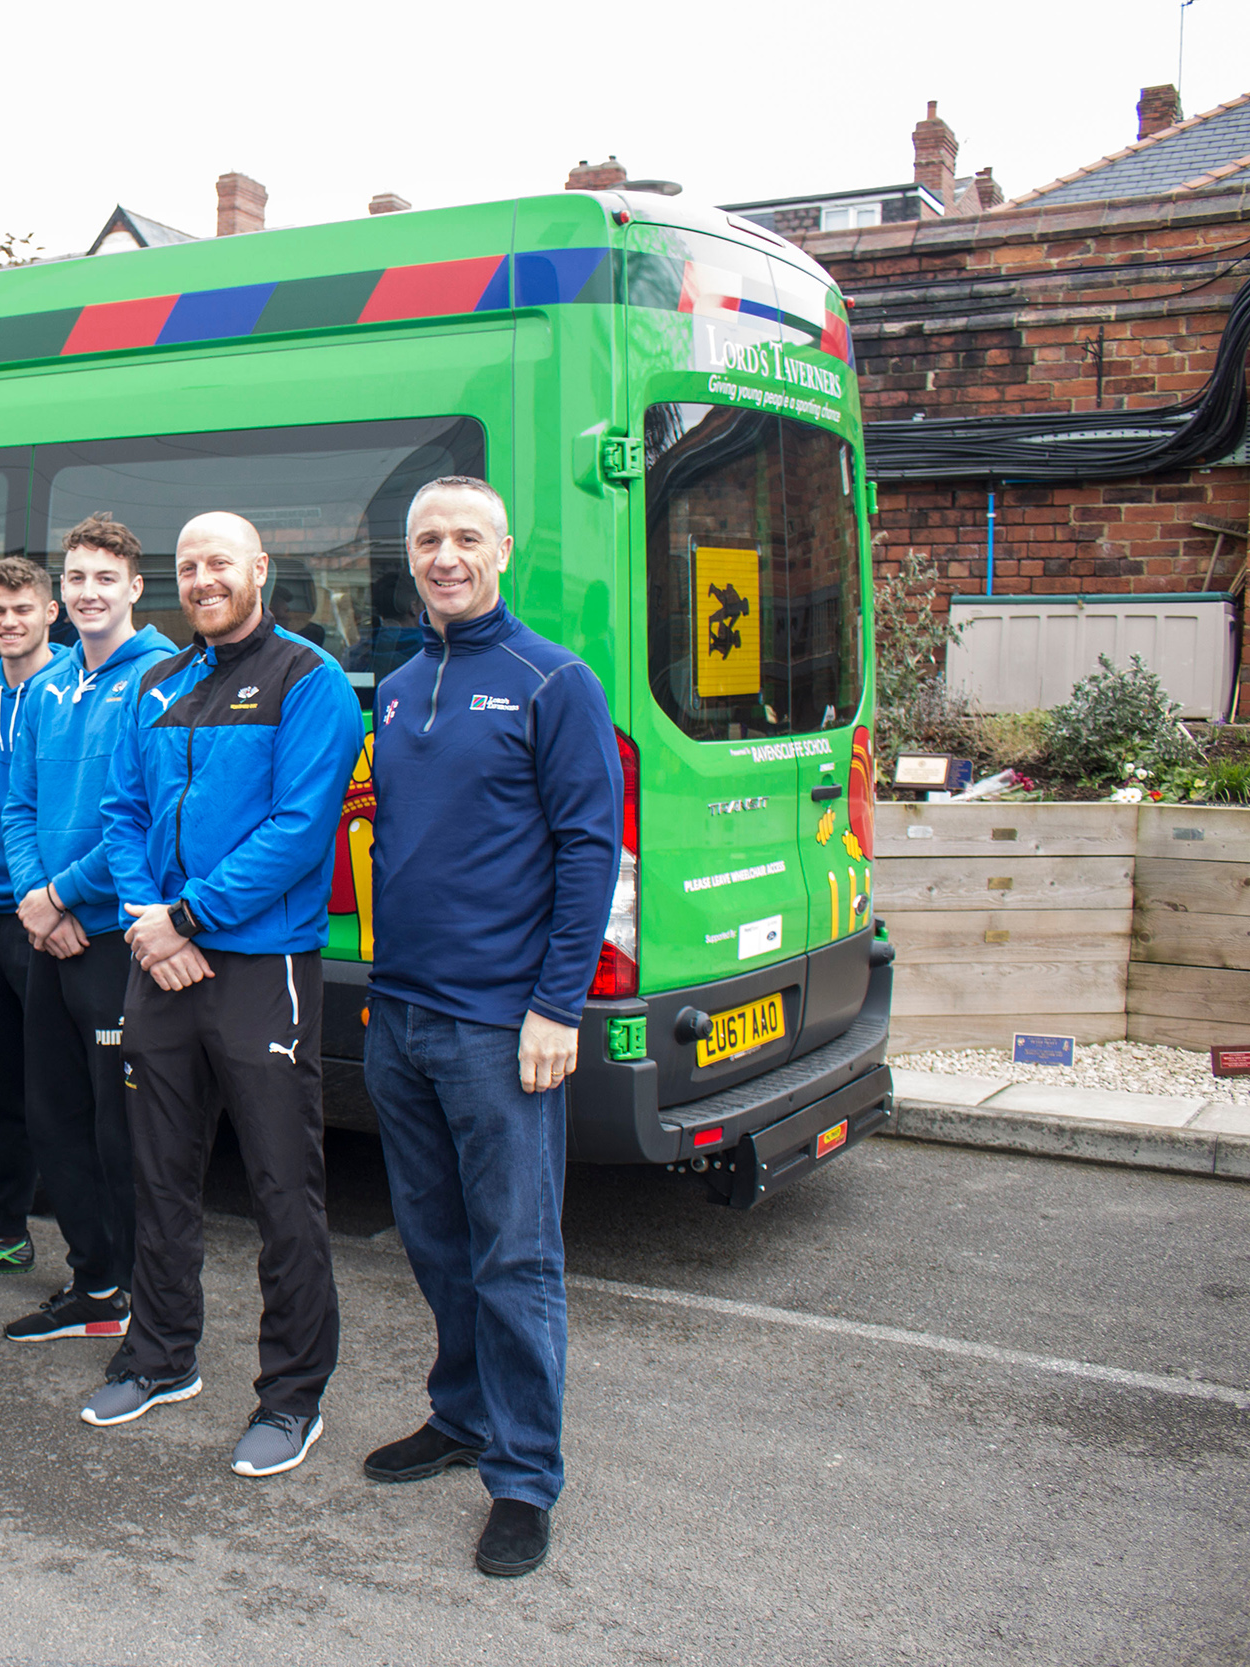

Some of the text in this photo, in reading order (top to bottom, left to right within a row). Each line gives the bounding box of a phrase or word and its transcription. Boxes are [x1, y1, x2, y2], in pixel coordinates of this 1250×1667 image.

[708, 374, 737, 401] Giving
[737, 385, 763, 406] young
[762, 389, 789, 410] people
[790, 397, 796, 409] a
[795, 398, 821, 420] sporting
[751, 742, 805, 763] RAVENSCLIFFE
[803, 738, 833, 757] SCHOOL
[707, 795, 770, 817] TRANSIT
[683, 876, 712, 893] PLEASE
[711, 872, 732, 888] LEAVE
[766, 860, 787, 875] ACCESS
[752, 1001, 778, 1041] AAO
[95, 1029, 124, 1046] PUM
